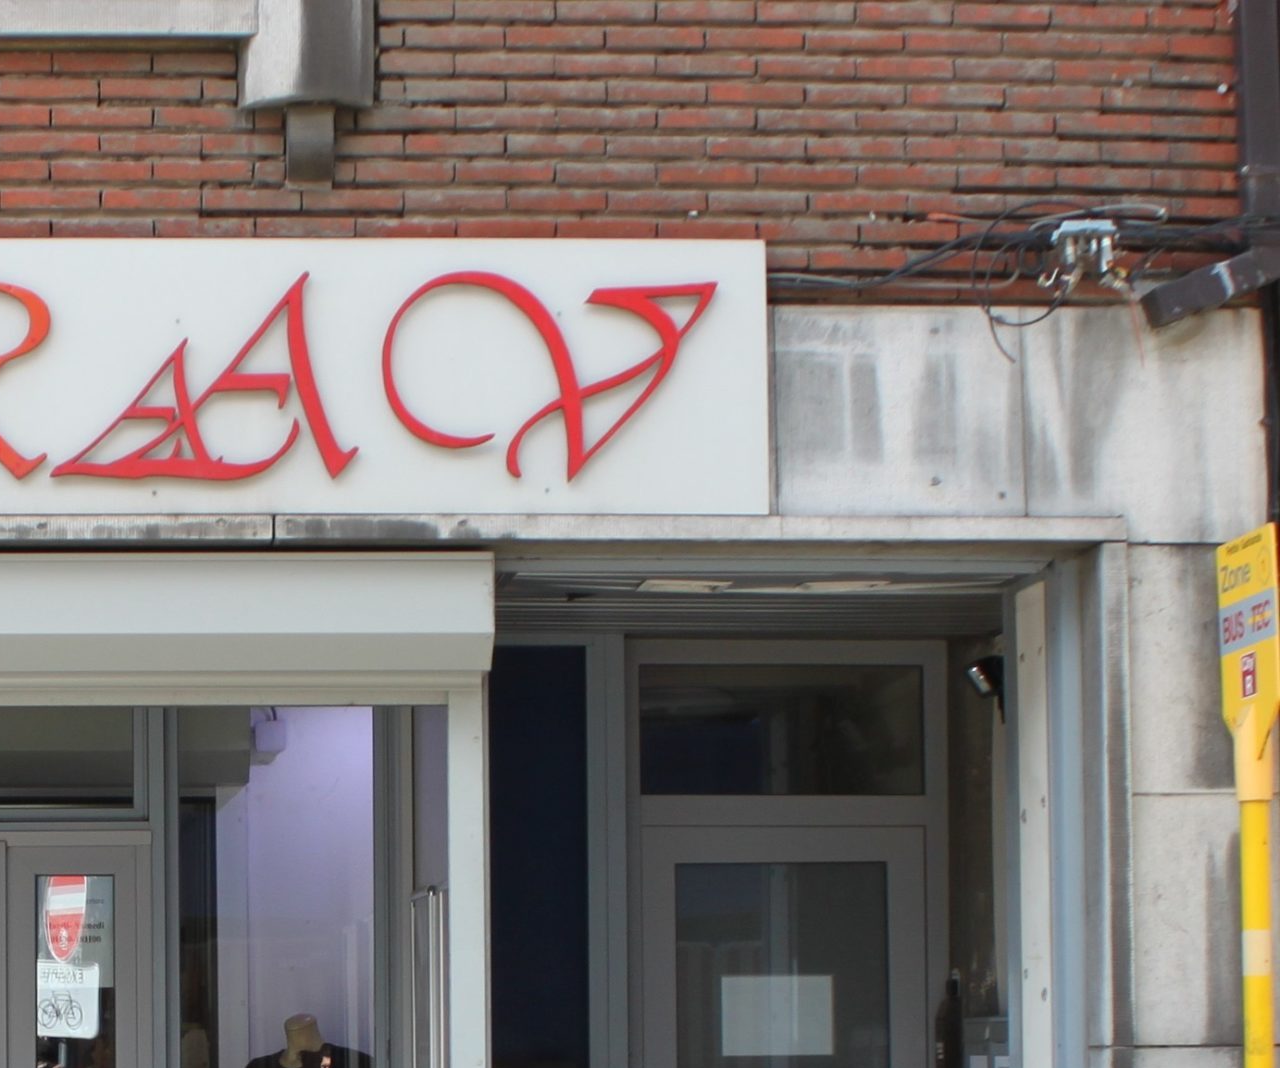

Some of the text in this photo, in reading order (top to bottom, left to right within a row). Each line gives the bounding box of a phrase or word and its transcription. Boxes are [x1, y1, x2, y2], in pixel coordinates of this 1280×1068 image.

[1220, 563, 1252, 593] Zone
[1222, 599, 1272, 645] BUS TEC
